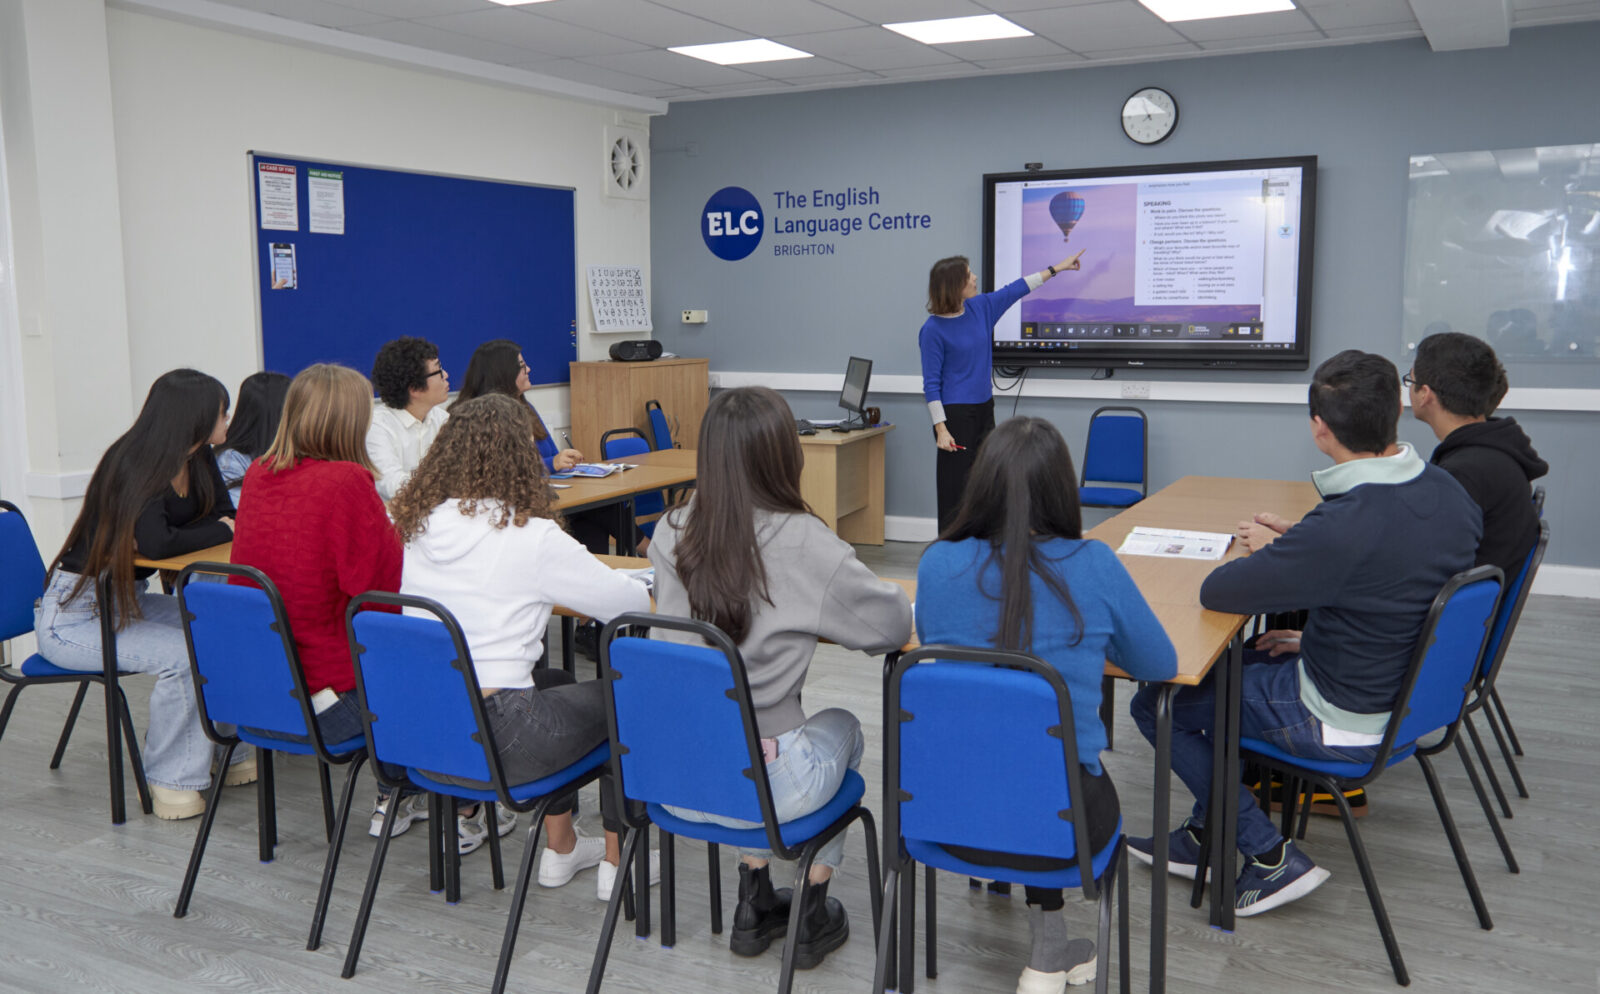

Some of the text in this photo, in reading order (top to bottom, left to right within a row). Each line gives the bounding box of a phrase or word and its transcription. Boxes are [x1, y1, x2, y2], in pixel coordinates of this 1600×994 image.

[774, 187, 879, 210] The English
[707, 210, 759, 236] ELC
[774, 212, 931, 236] Language Centre
[774, 244, 834, 256] BRIGHTON
